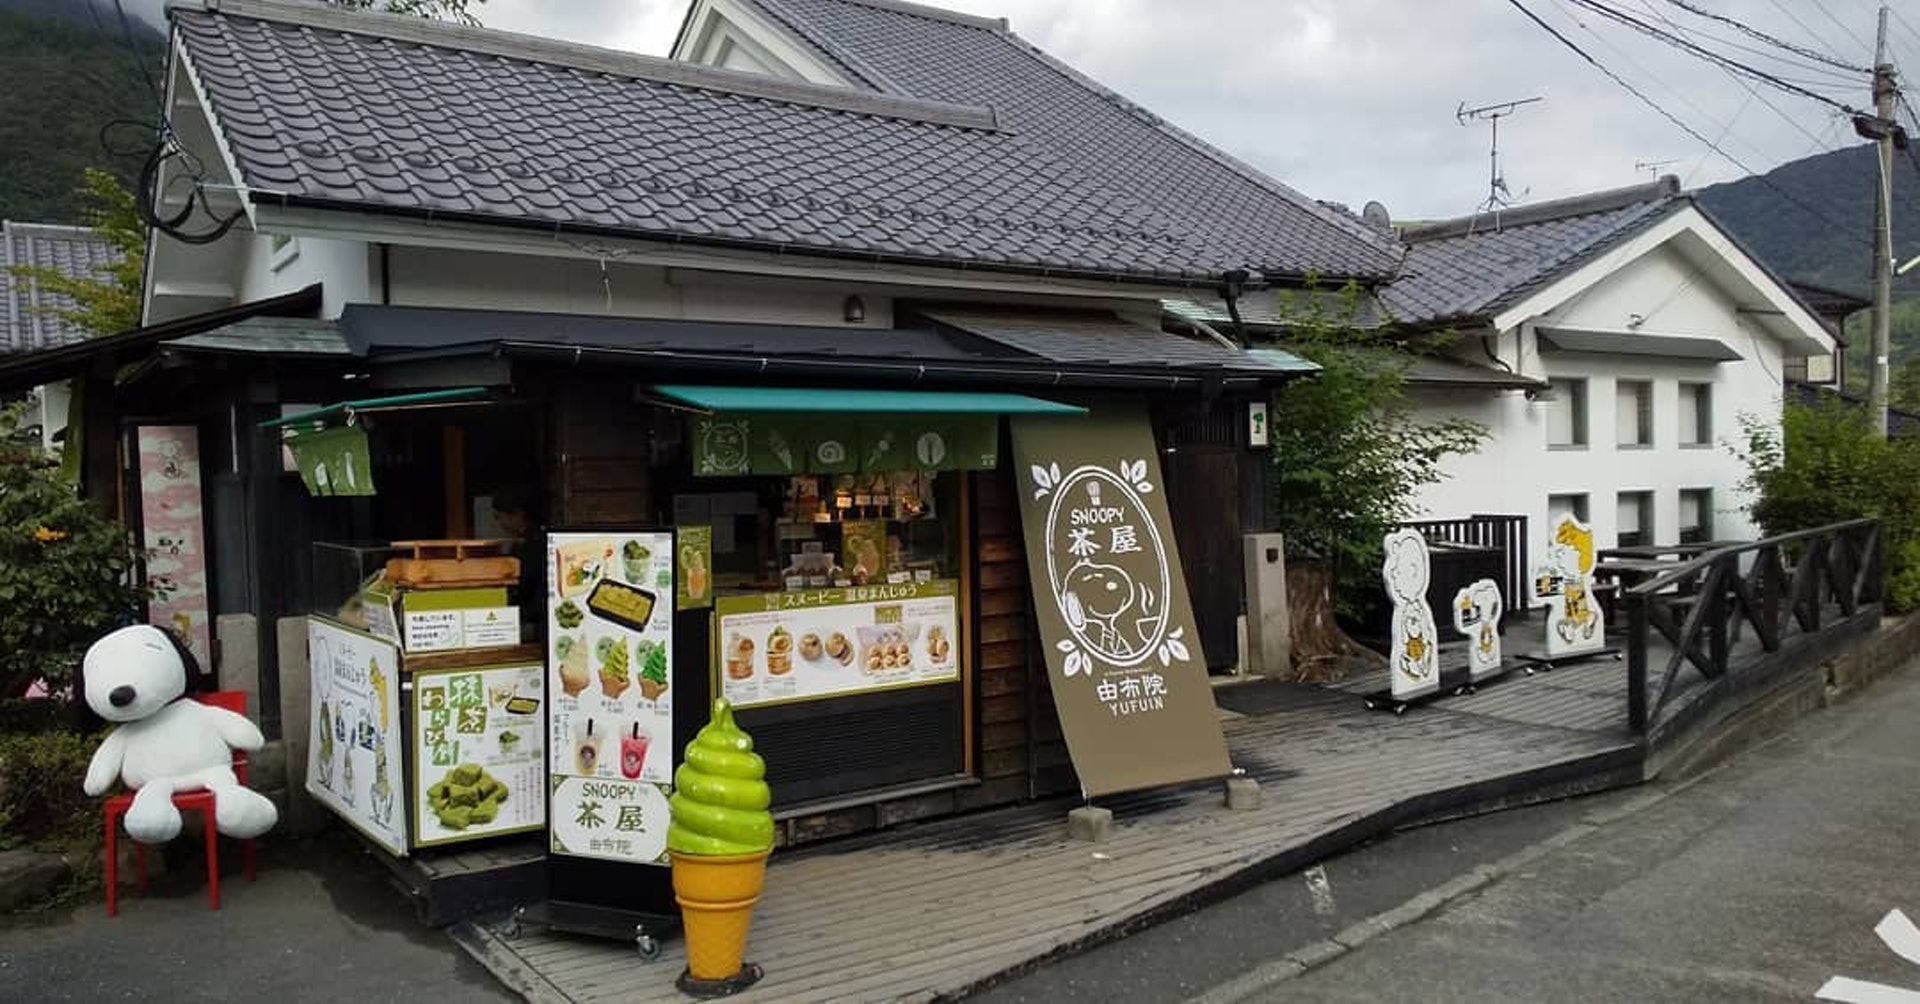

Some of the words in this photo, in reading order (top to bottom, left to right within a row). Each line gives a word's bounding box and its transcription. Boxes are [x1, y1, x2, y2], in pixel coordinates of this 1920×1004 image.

[1071, 507, 1125, 526] SNOOPY
[1067, 524, 1142, 556] 茶屋
[784, 590, 840, 607] スヌーピー
[1097, 674, 1167, 703] 由布院
[1109, 699, 1164, 717] YUFUIN
[582, 782, 636, 799] SNOOPY
[575, 801, 646, 833] 茶屋
